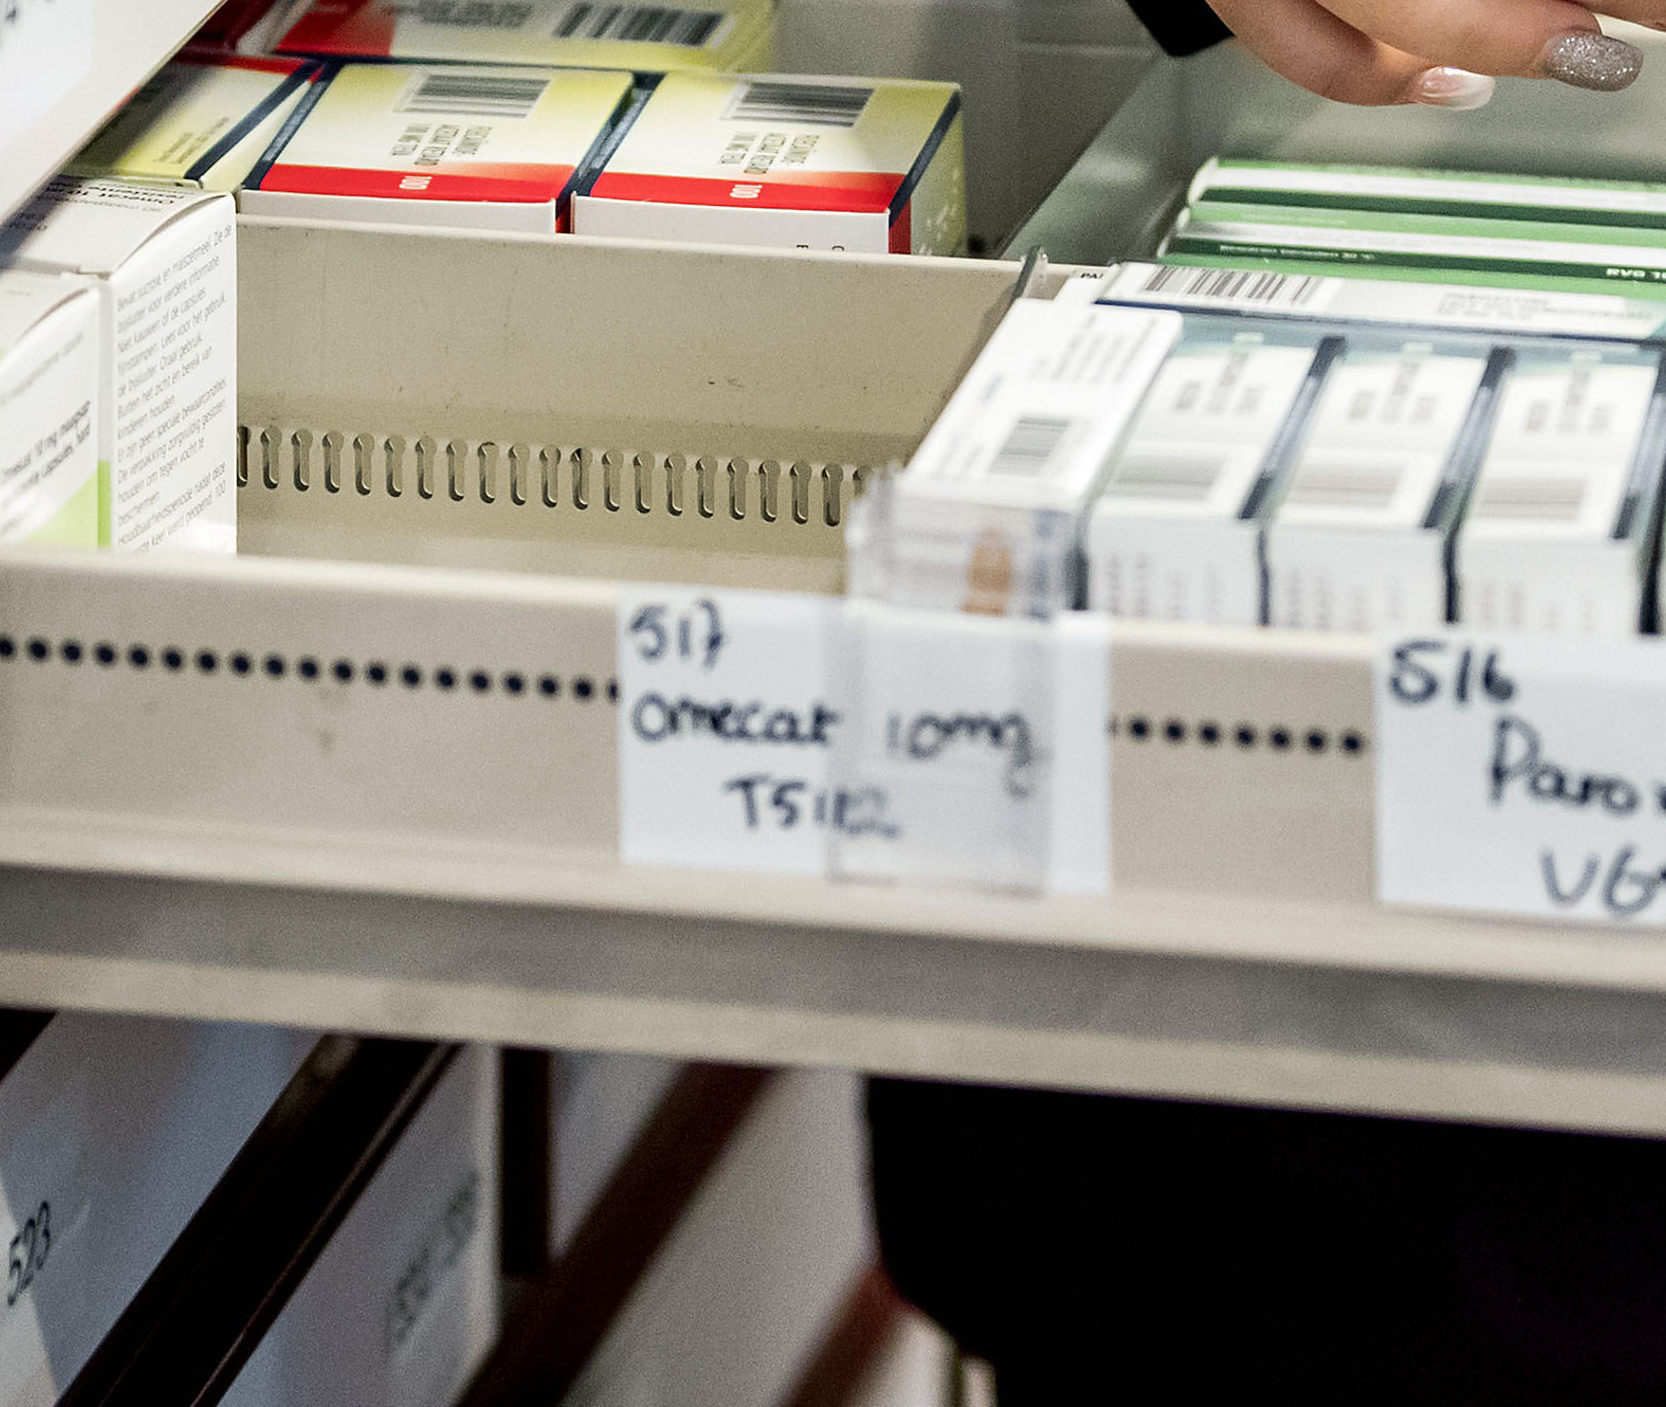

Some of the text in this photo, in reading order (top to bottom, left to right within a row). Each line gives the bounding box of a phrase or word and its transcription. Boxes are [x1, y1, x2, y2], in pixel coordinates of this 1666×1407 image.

[1605, 268, 1646, 278] RVG
[1389, 639, 1516, 704] 516
[8, 1200, 50, 1306] 523
